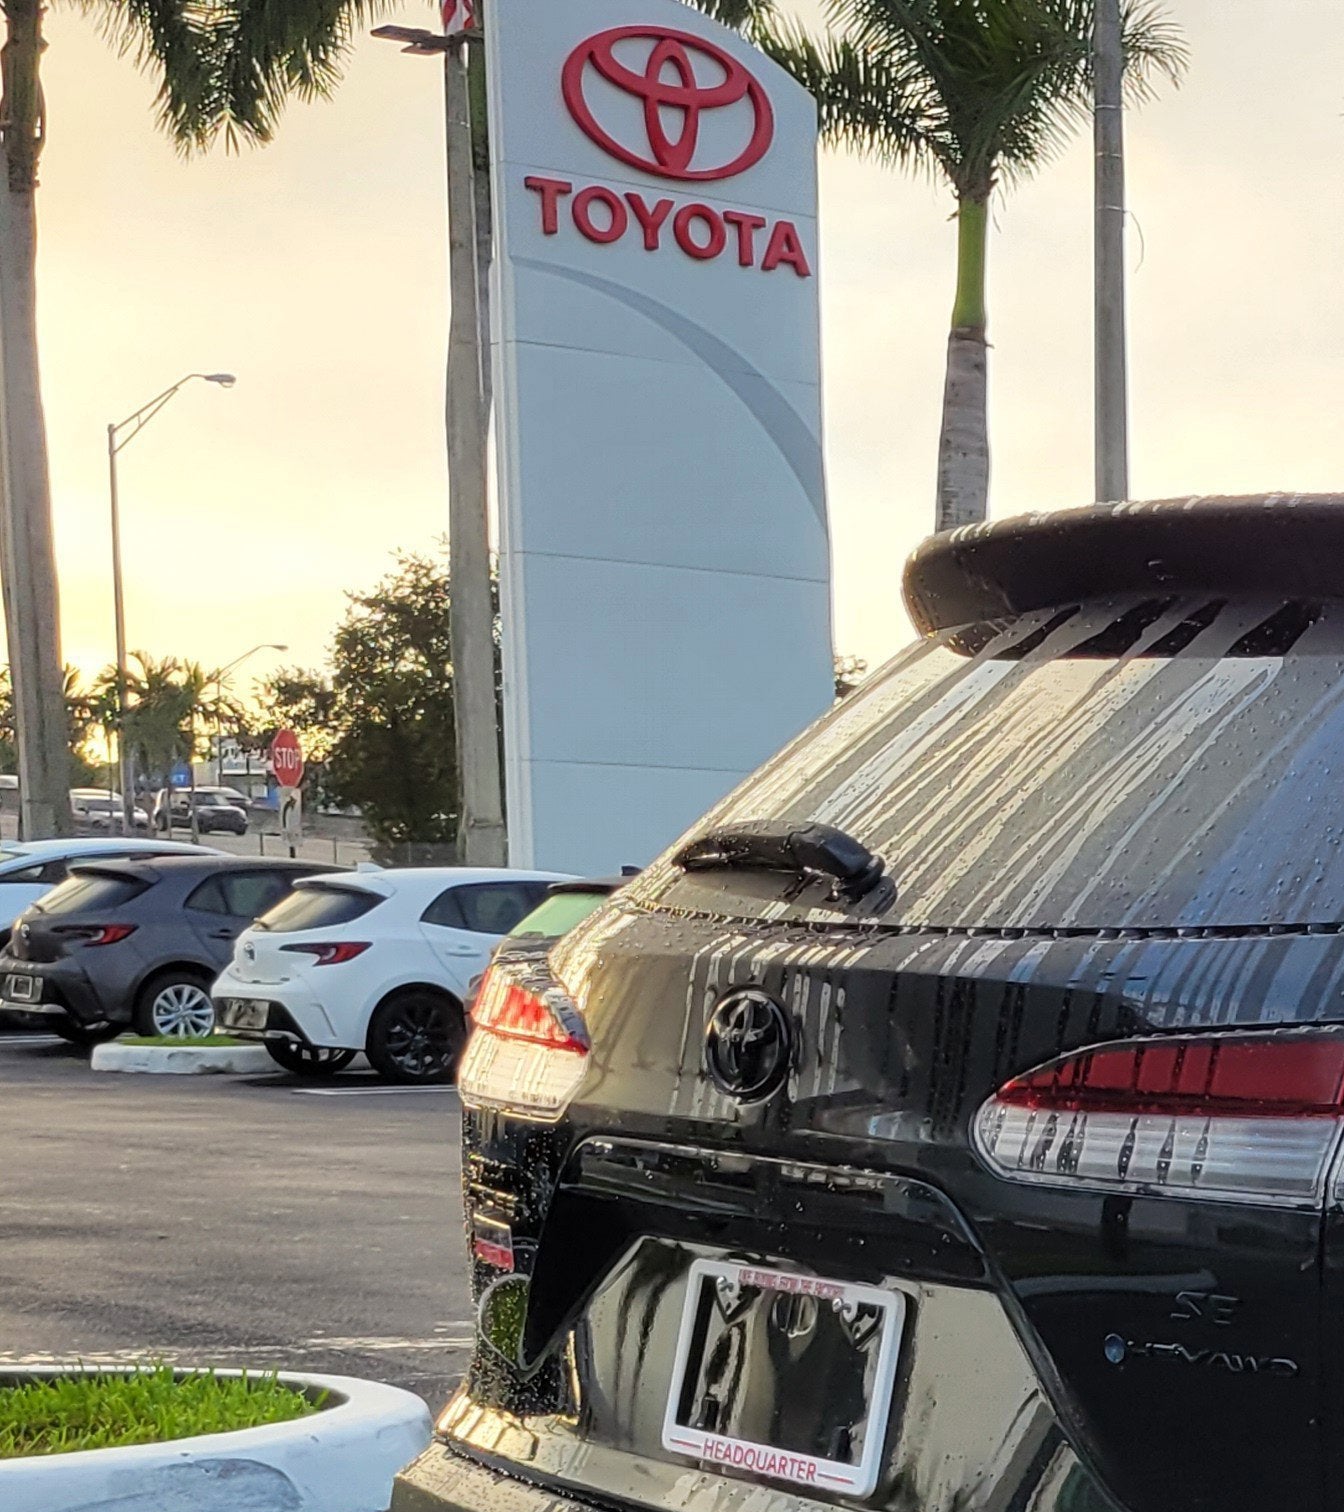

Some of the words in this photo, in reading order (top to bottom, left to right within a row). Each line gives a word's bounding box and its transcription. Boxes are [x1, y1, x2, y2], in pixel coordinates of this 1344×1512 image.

[524, 176, 811, 277] TOYOTA
[275, 747, 299, 769] STOP
[702, 1438, 817, 1482] HEADQUARTER
